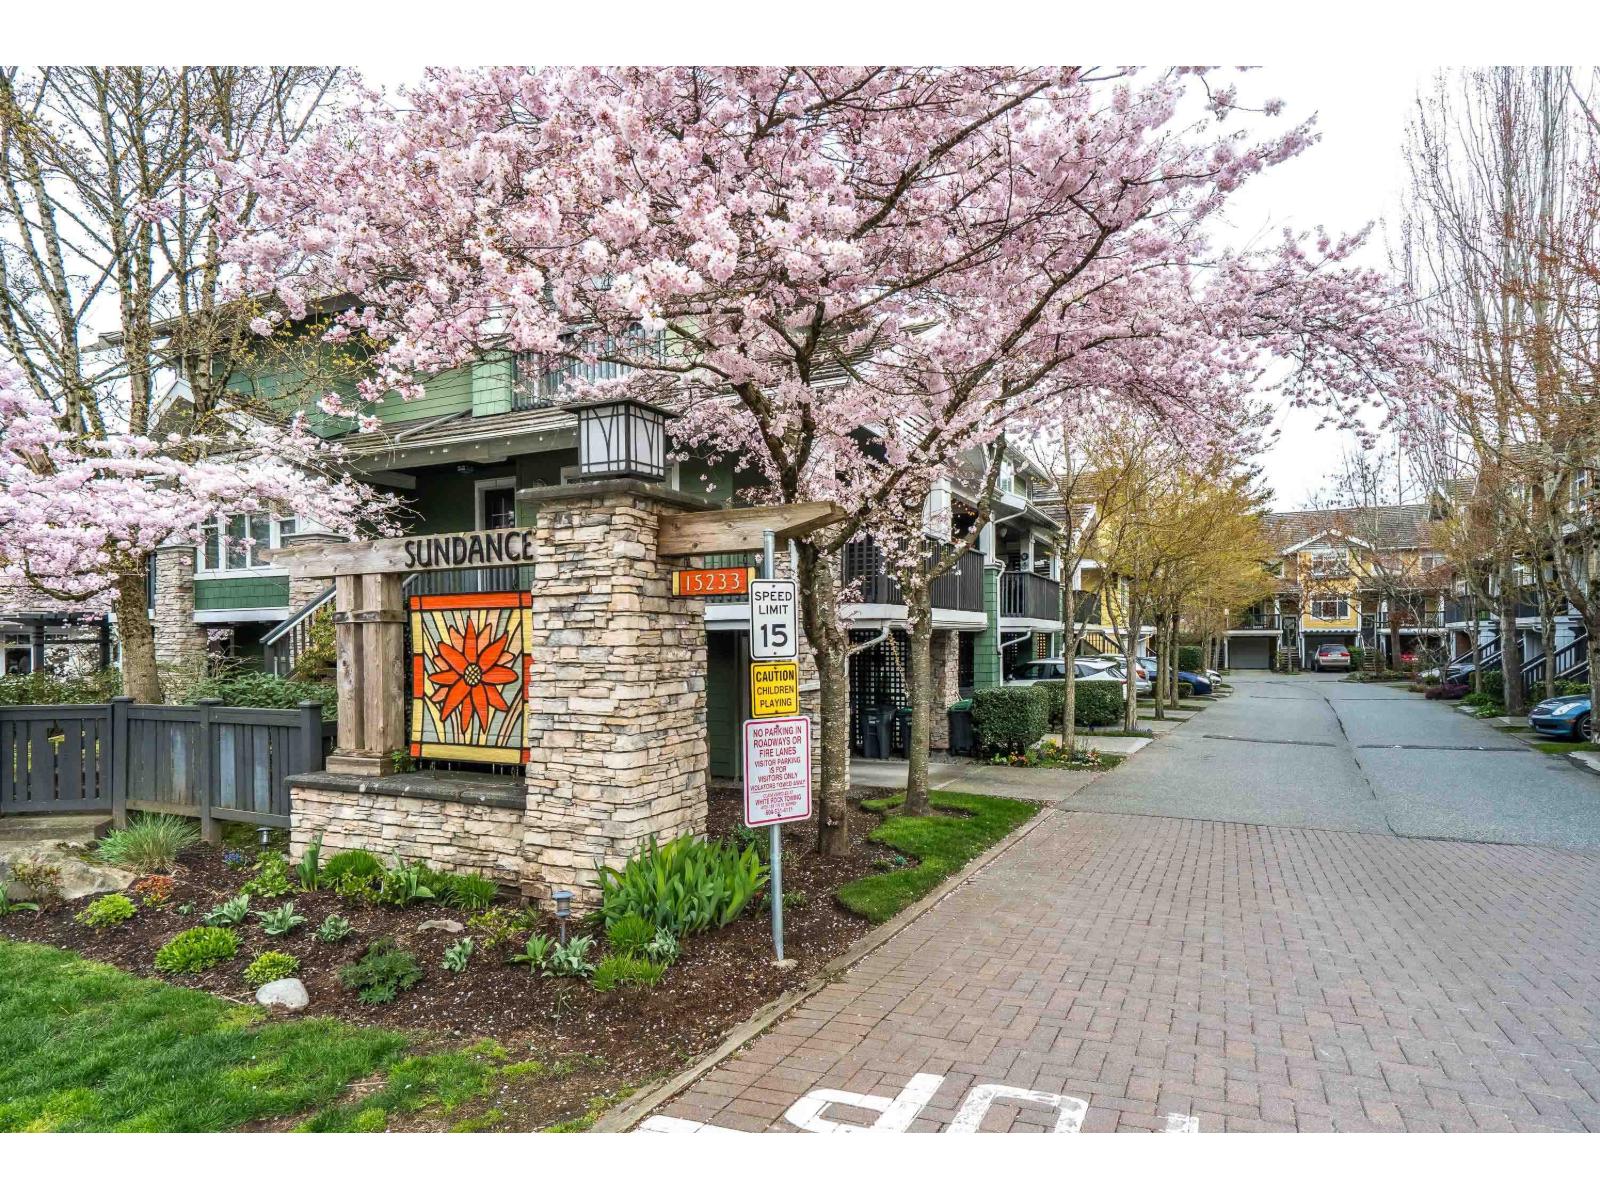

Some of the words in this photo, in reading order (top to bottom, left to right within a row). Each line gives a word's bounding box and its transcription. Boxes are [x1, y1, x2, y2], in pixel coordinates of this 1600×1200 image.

[404, 532, 534, 569] SUNDANCE
[686, 572, 740, 591] 15233
[754, 591, 793, 602] SPEED
[758, 605, 789, 615] LIMIT
[760, 623, 788, 648] 15
[755, 670, 795, 683] CAUTION
[756, 685, 794, 696] CHILDREN
[759, 698, 792, 708] PLAYING
[753, 729, 763, 737] NO
[765, 726, 793, 736] PARKING
[796, 726, 802, 734] IN
[754, 737, 790, 748] ROADWAYS
[792, 736, 801, 744] OR
[760, 749, 773, 757] FIRE
[776, 747, 796, 756] LANES
[758, 775, 782, 783] VISITORS
